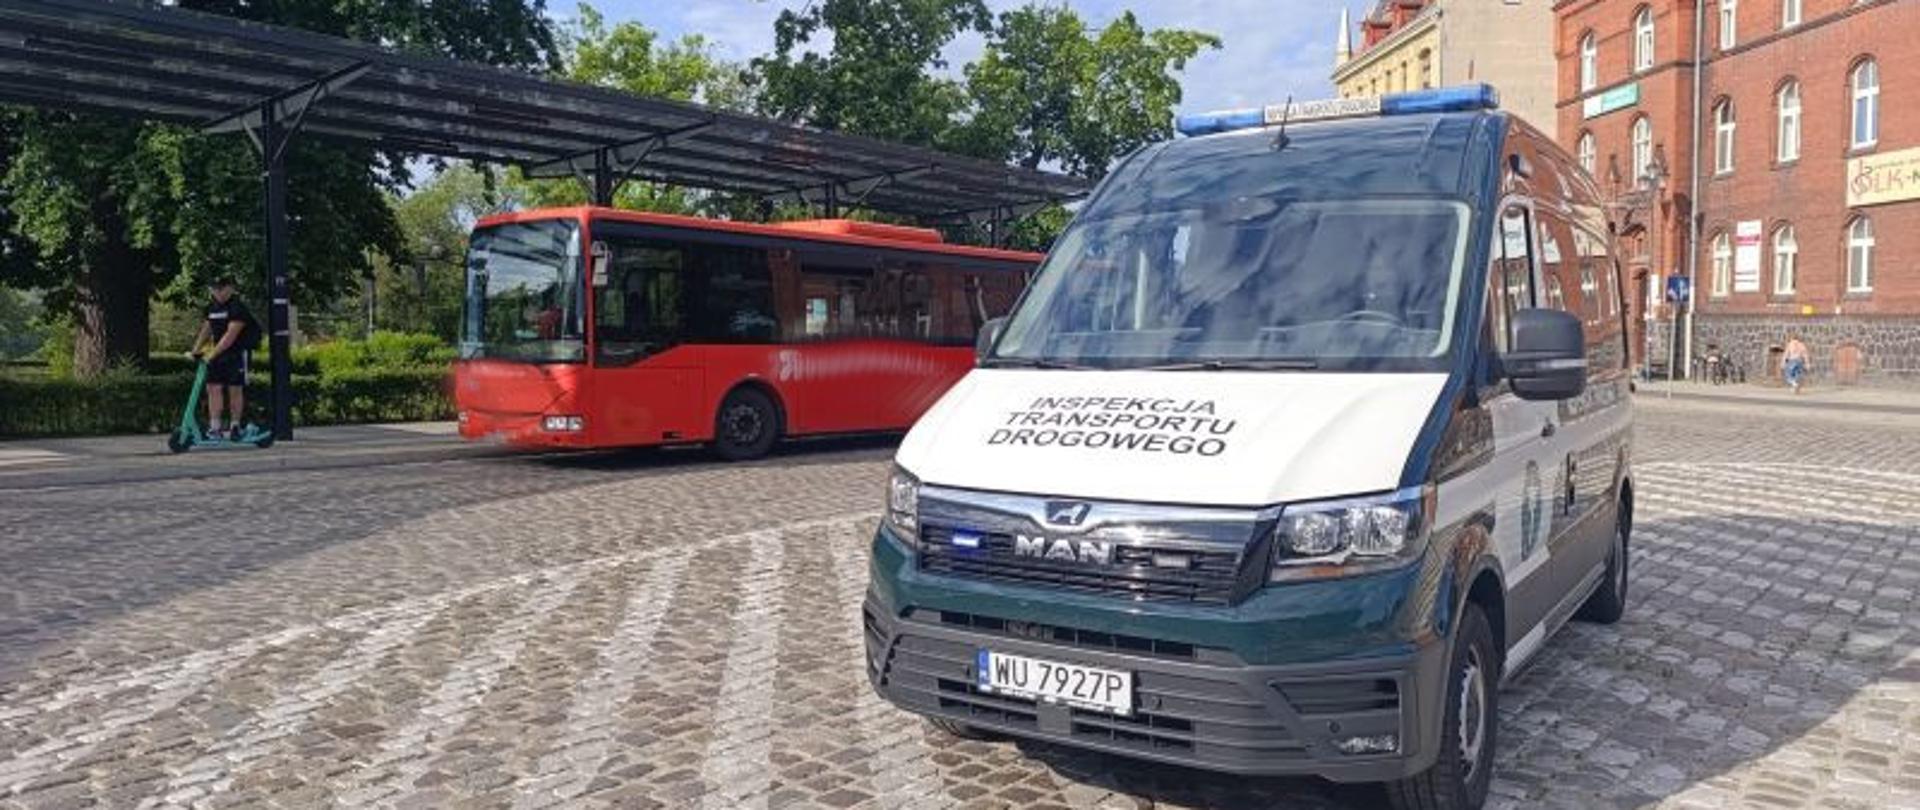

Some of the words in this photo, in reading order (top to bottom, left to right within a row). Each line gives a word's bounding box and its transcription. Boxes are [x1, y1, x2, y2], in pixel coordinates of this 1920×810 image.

[1029, 396, 1216, 415] INSPEKCJA
[1005, 412, 1236, 435] TRANSPORTU
[987, 429, 1227, 456] DROGOWEGO
[1015, 535, 1111, 566] MAN
[996, 656, 1028, 687] WU
[1038, 662, 1123, 702] 7927P
